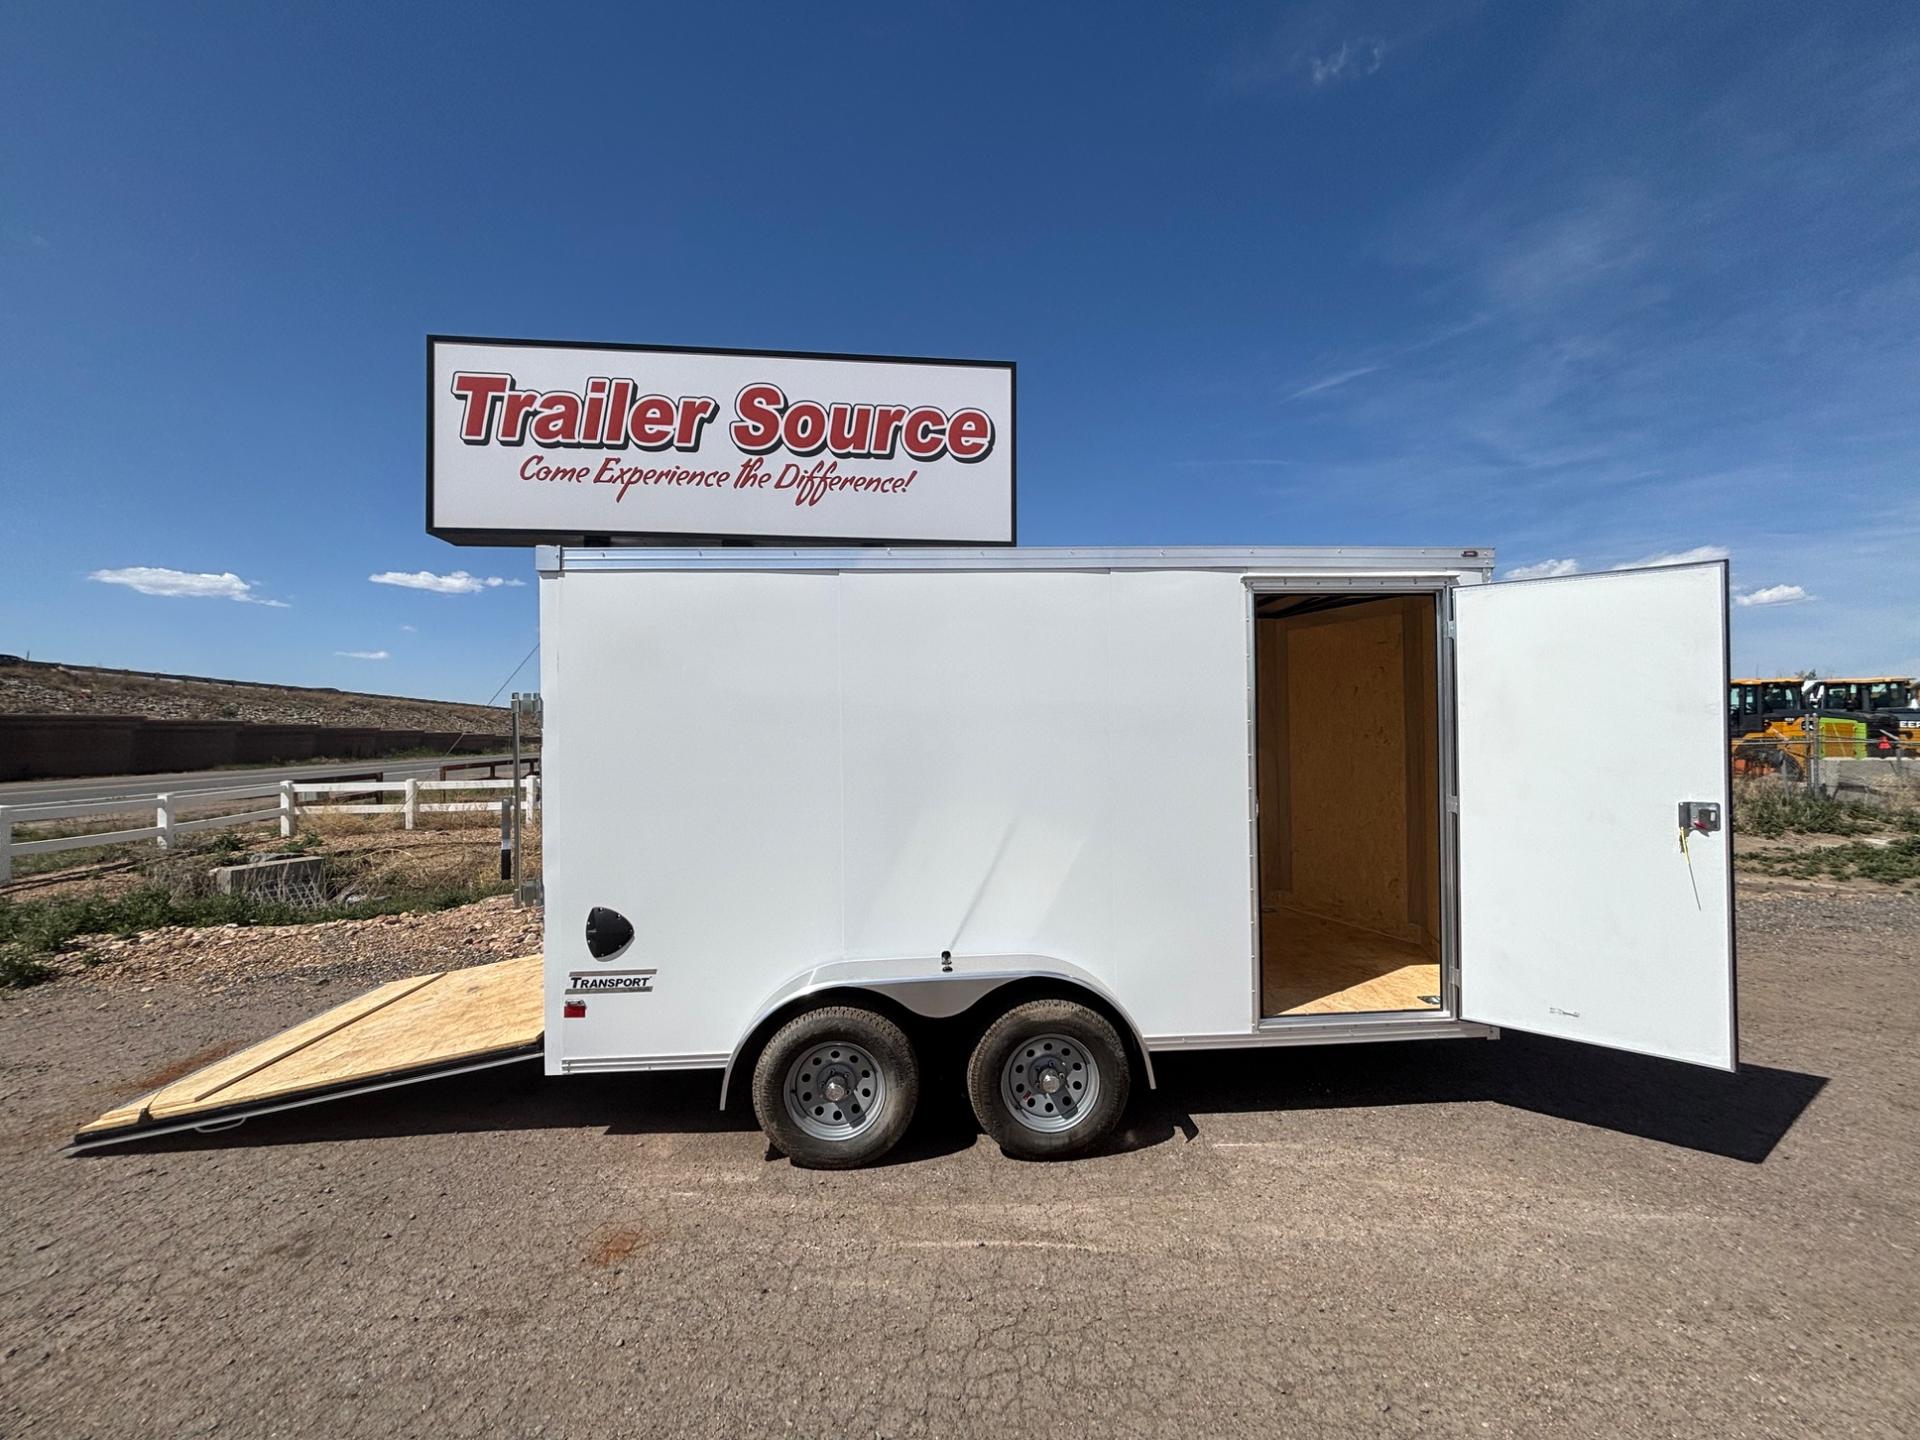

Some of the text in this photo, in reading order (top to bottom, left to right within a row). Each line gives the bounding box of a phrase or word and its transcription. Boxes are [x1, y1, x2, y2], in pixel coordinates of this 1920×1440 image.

[452, 371, 995, 463] Trailer Source
[520, 455, 917, 506] Come Experience the Difference!
[571, 977, 650, 989] TRANSPORT
